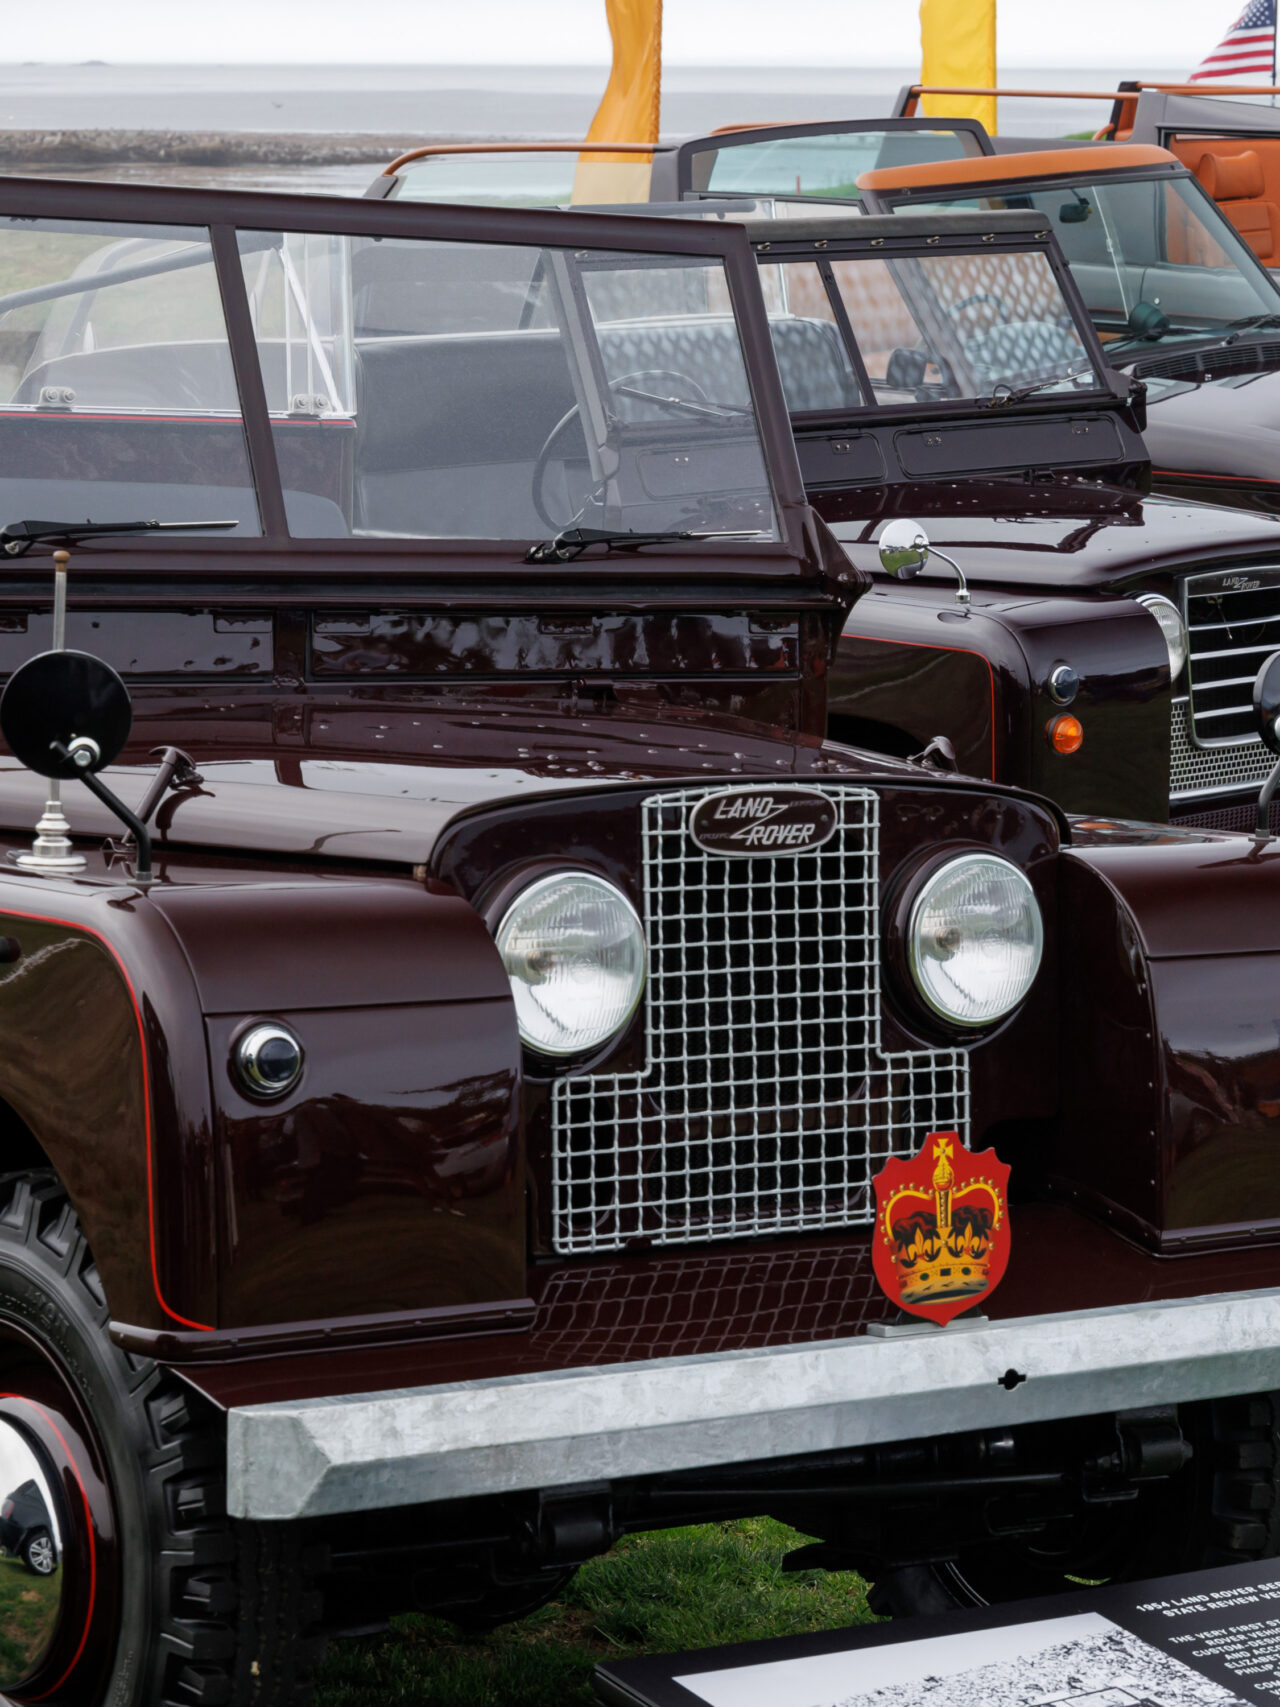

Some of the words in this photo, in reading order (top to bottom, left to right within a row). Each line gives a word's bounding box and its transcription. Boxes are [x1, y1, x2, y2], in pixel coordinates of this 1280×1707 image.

[1222, 577, 1240, 587] LAND
[1240, 580, 1260, 591] ROVER
[713, 797, 774, 819] LAND
[745, 823, 816, 846] ROVER
[1136, 1601, 1169, 1611] 1954
[1171, 1594, 1208, 1605] LAND
[1210, 1586, 1256, 1598] ROVER
[1162, 1605, 1206, 1616] STATE
[1207, 1595, 1258, 1608] REVIEW
[1168, 1634, 1195, 1643] THE
[1195, 1629, 1227, 1638] VERY
[1228, 1622, 1264, 1632] FIRST
[1205, 1634, 1247, 1645] ROVER
[1225, 1651, 1250, 1659] AND
